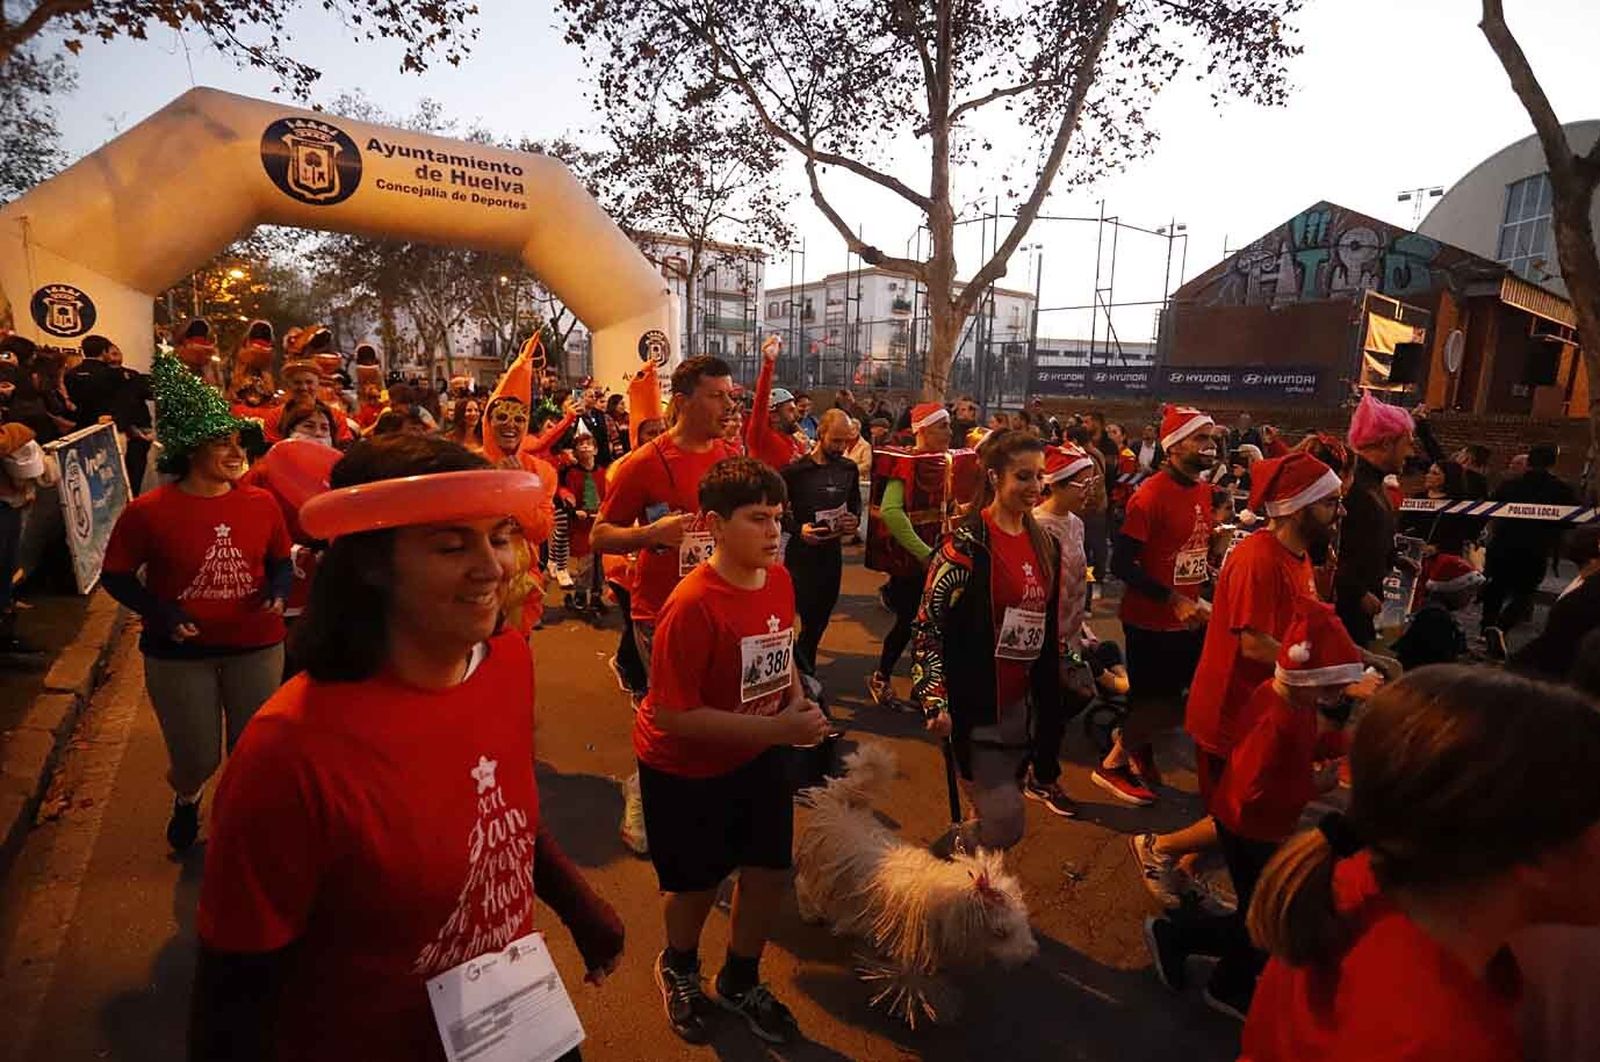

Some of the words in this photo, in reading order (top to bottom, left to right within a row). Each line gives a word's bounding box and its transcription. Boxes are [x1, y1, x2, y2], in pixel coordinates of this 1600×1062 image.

[366, 137, 524, 177] Ayuntamiento
[415, 164, 443, 182] de
[451, 169, 525, 195] Huelva
[452, 190, 467, 202] de
[471, 192, 528, 211] Deportes
[1186, 374, 1232, 384] HYUNDAI
[1263, 374, 1316, 385] HYUNDAI
[1537, 507, 1561, 517] LOCAL
[764, 647, 790, 677] 380
